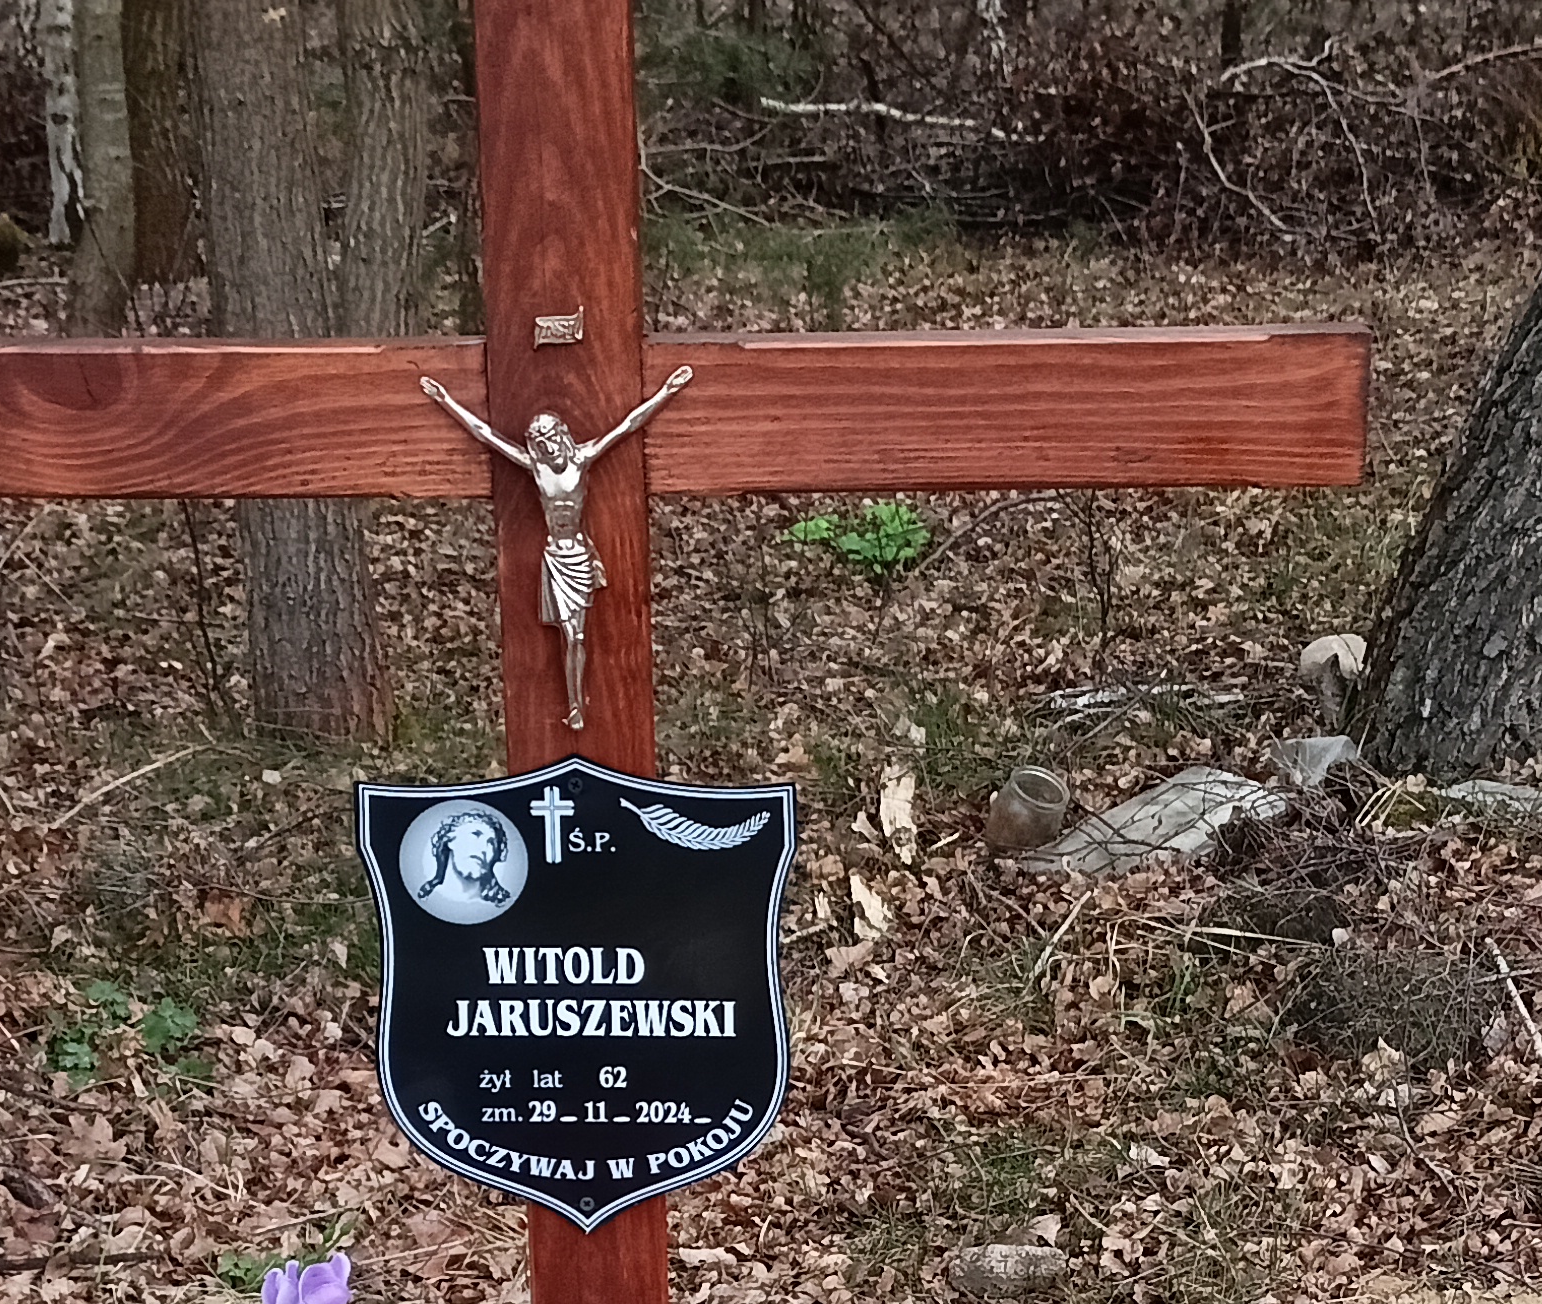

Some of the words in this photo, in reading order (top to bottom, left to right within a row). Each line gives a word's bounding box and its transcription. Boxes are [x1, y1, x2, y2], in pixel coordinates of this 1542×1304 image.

[568, 827, 616, 852] Ś.P.
[482, 947, 645, 985] WITOLD
[446, 999, 737, 1038] JARUSZEWSKI
[479, 1069, 512, 1093] żył
[532, 1069, 564, 1088] lat
[598, 1066, 628, 1089] 62
[481, 1107, 523, 1123] zm.
[528, 1100, 557, 1123] 29
[583, 1100, 609, 1123] 11
[418, 1101, 596, 1180] SPOCZYWAJ
[606, 1157, 635, 1180] W
[646, 1098, 754, 1175] POKOJU
